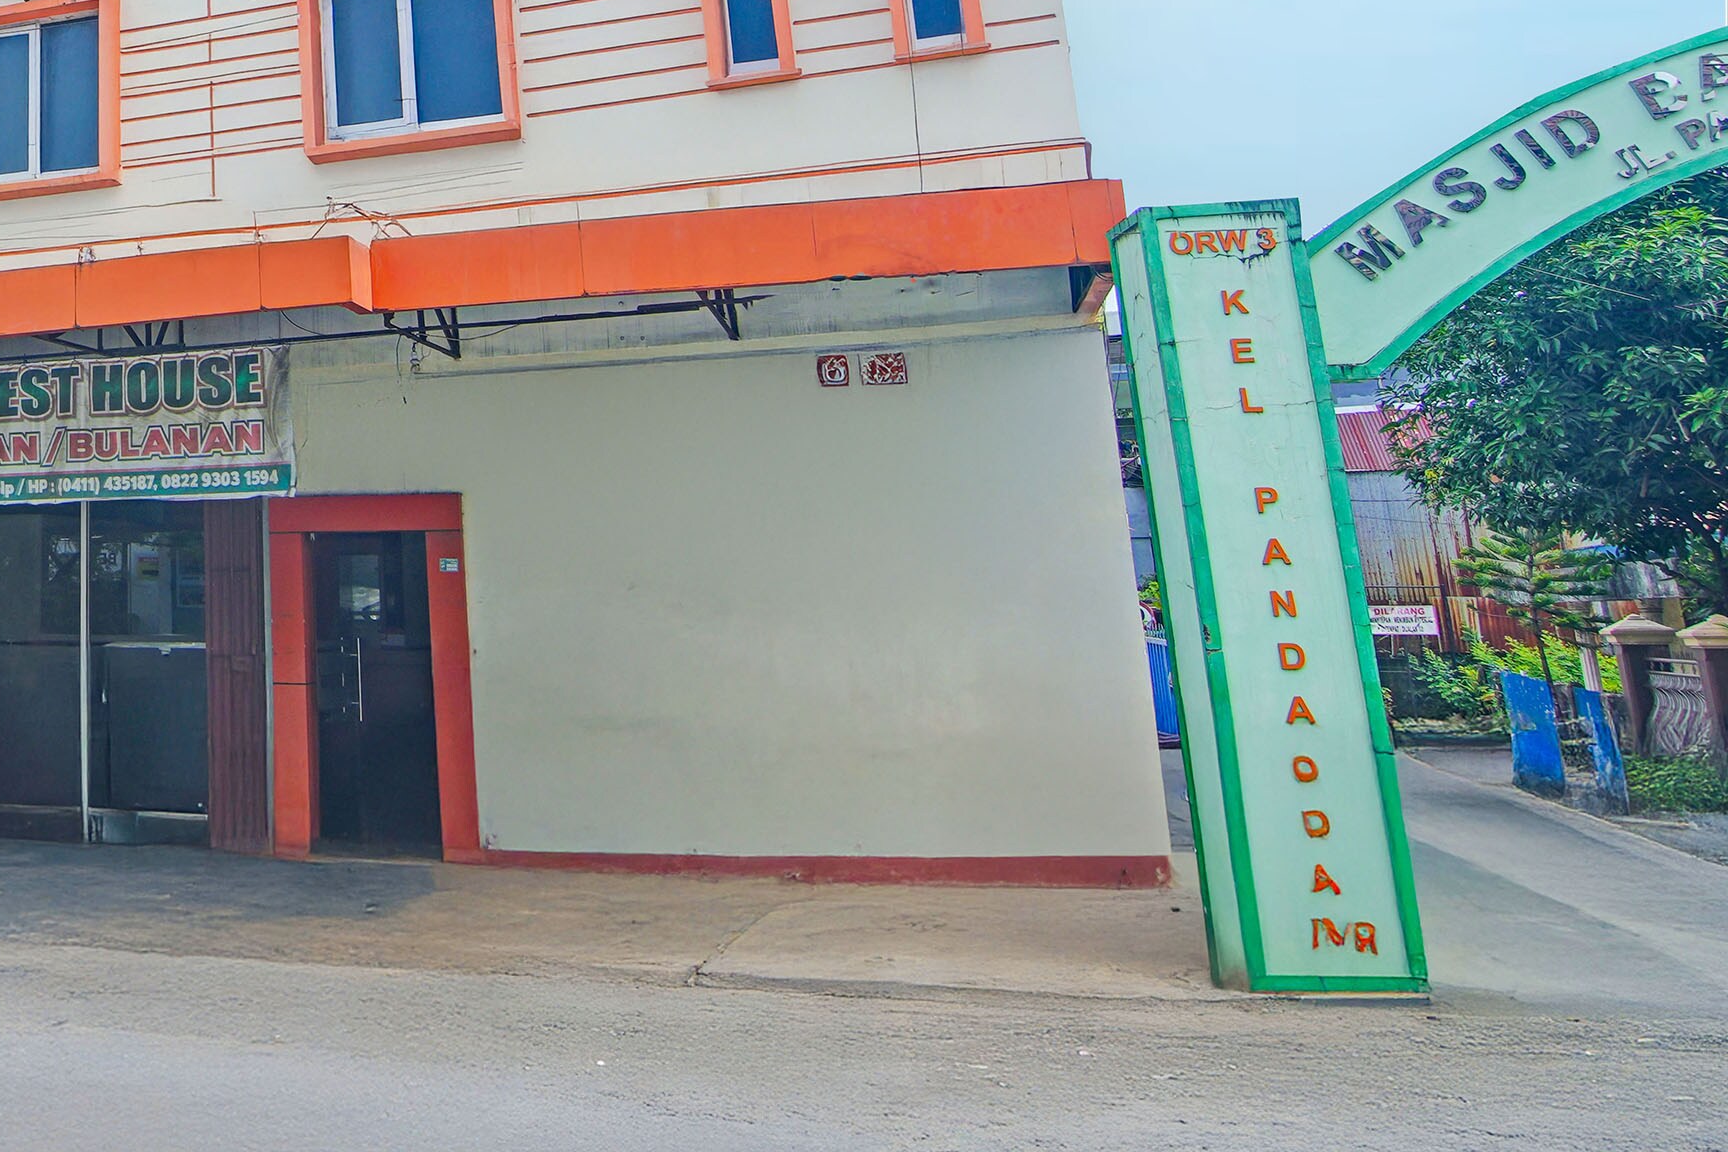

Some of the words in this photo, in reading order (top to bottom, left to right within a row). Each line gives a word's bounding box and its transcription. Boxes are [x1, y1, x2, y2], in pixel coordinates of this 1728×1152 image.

[1334, 109, 1601, 283] MASJID
[1256, 227, 1278, 251] 3
[1221, 289, 1264, 414] KEL
[90, 351, 265, 416] HOUSE
[67, 419, 265, 462] BULANAN
[58, 476, 100, 496] (0411)
[104, 474, 158, 491] 435187,
[161, 472, 199, 489] 0822
[202, 470, 241, 486] 9303
[244, 469, 279, 485] 1594
